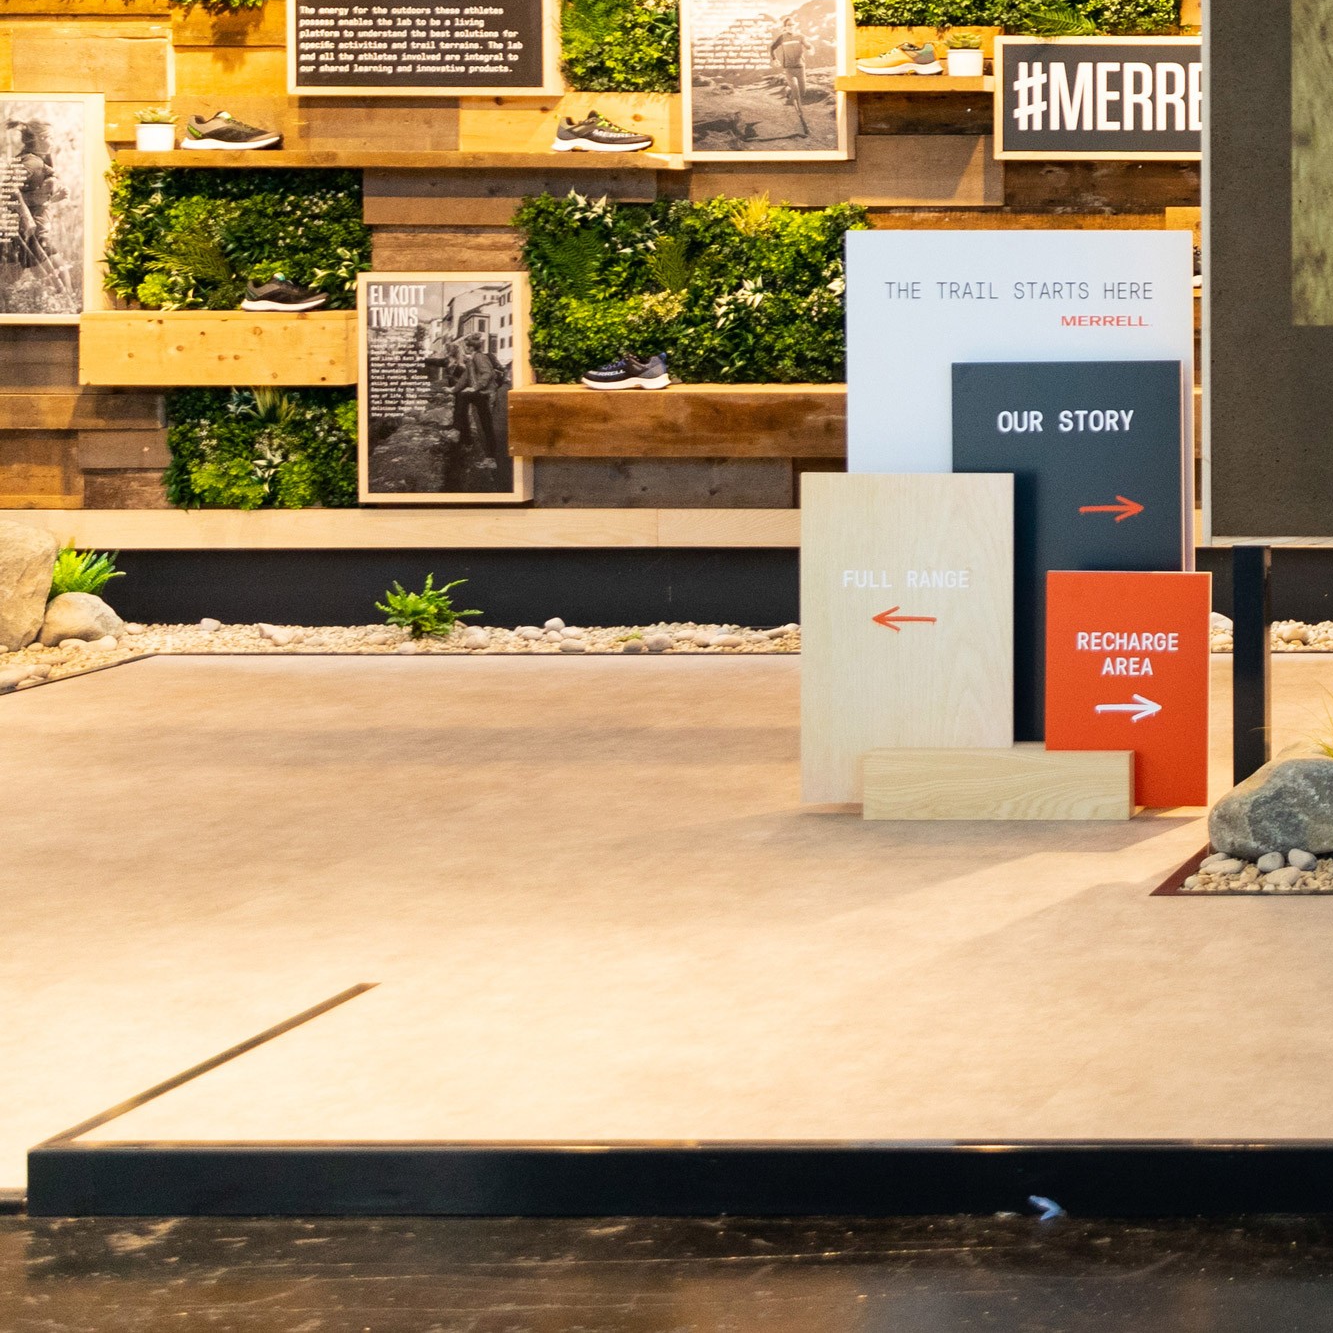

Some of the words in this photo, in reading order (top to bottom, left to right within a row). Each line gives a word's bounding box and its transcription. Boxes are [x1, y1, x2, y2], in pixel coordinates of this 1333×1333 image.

[299, 6, 314, 15] The
[318, 7, 348, 17] energy
[352, 6, 368, 15] for
[372, 6, 387, 15] the
[392, 6, 431, 15] outdoors
[436, 6, 461, 15] these
[465, 6, 505, 15] athletes
[299, 19, 334, 29] possess
[338, 18, 373, 27] enables
[377, 18, 393, 27] the
[397, 18, 412, 27] lab
[416, 18, 427, 27] to
[431, 18, 442, 27] be
[446, 19, 451, 27] a
[456, 18, 486, 29] living
[299, 29, 339, 40] platform
[343, 29, 353, 38] to
[358, 29, 407, 38] understand
[411, 29, 427, 38] the
[431, 29, 451, 38] best
[455, 29, 500, 38] solutions
[504, 29, 520, 38] for
[299, 41, 334, 52] specific
[338, 41, 387, 50] activities
[392, 41, 407, 50] and
[411, 41, 436, 50] trail
[489, 41, 504, 50] The
[508, 41, 524, 50] lab
[299, 53, 314, 62] and
[319, 53, 334, 62] all
[338, 53, 354, 62] the
[358, 53, 398, 62] athletes
[402, 53, 442, 62] involved
[446, 54, 461, 62] are
[465, 53, 505, 64] integral
[509, 53, 520, 62] to
[319, 64, 348, 73] shared
[353, 64, 392, 75] learning
[396, 64, 412, 73] and
[416, 64, 465, 73] innovative
[370, 285, 386, 305] EL
[390, 285, 426, 305] KOTT
[885, 282, 921, 300] THE
[936, 282, 999, 300] TRAIL
[1013, 282, 1090, 300] STARTS
[1103, 282, 1153, 300] HERE
[370, 307, 418, 327] TWINS
[997, 411, 1044, 433] OUR
[1058, 410, 1134, 433] STORY
[843, 570, 892, 589] FULL
[907, 570, 970, 589] RANGE
[1077, 632, 1179, 652] RECHARGE
[1102, 657, 1154, 676] AREA
